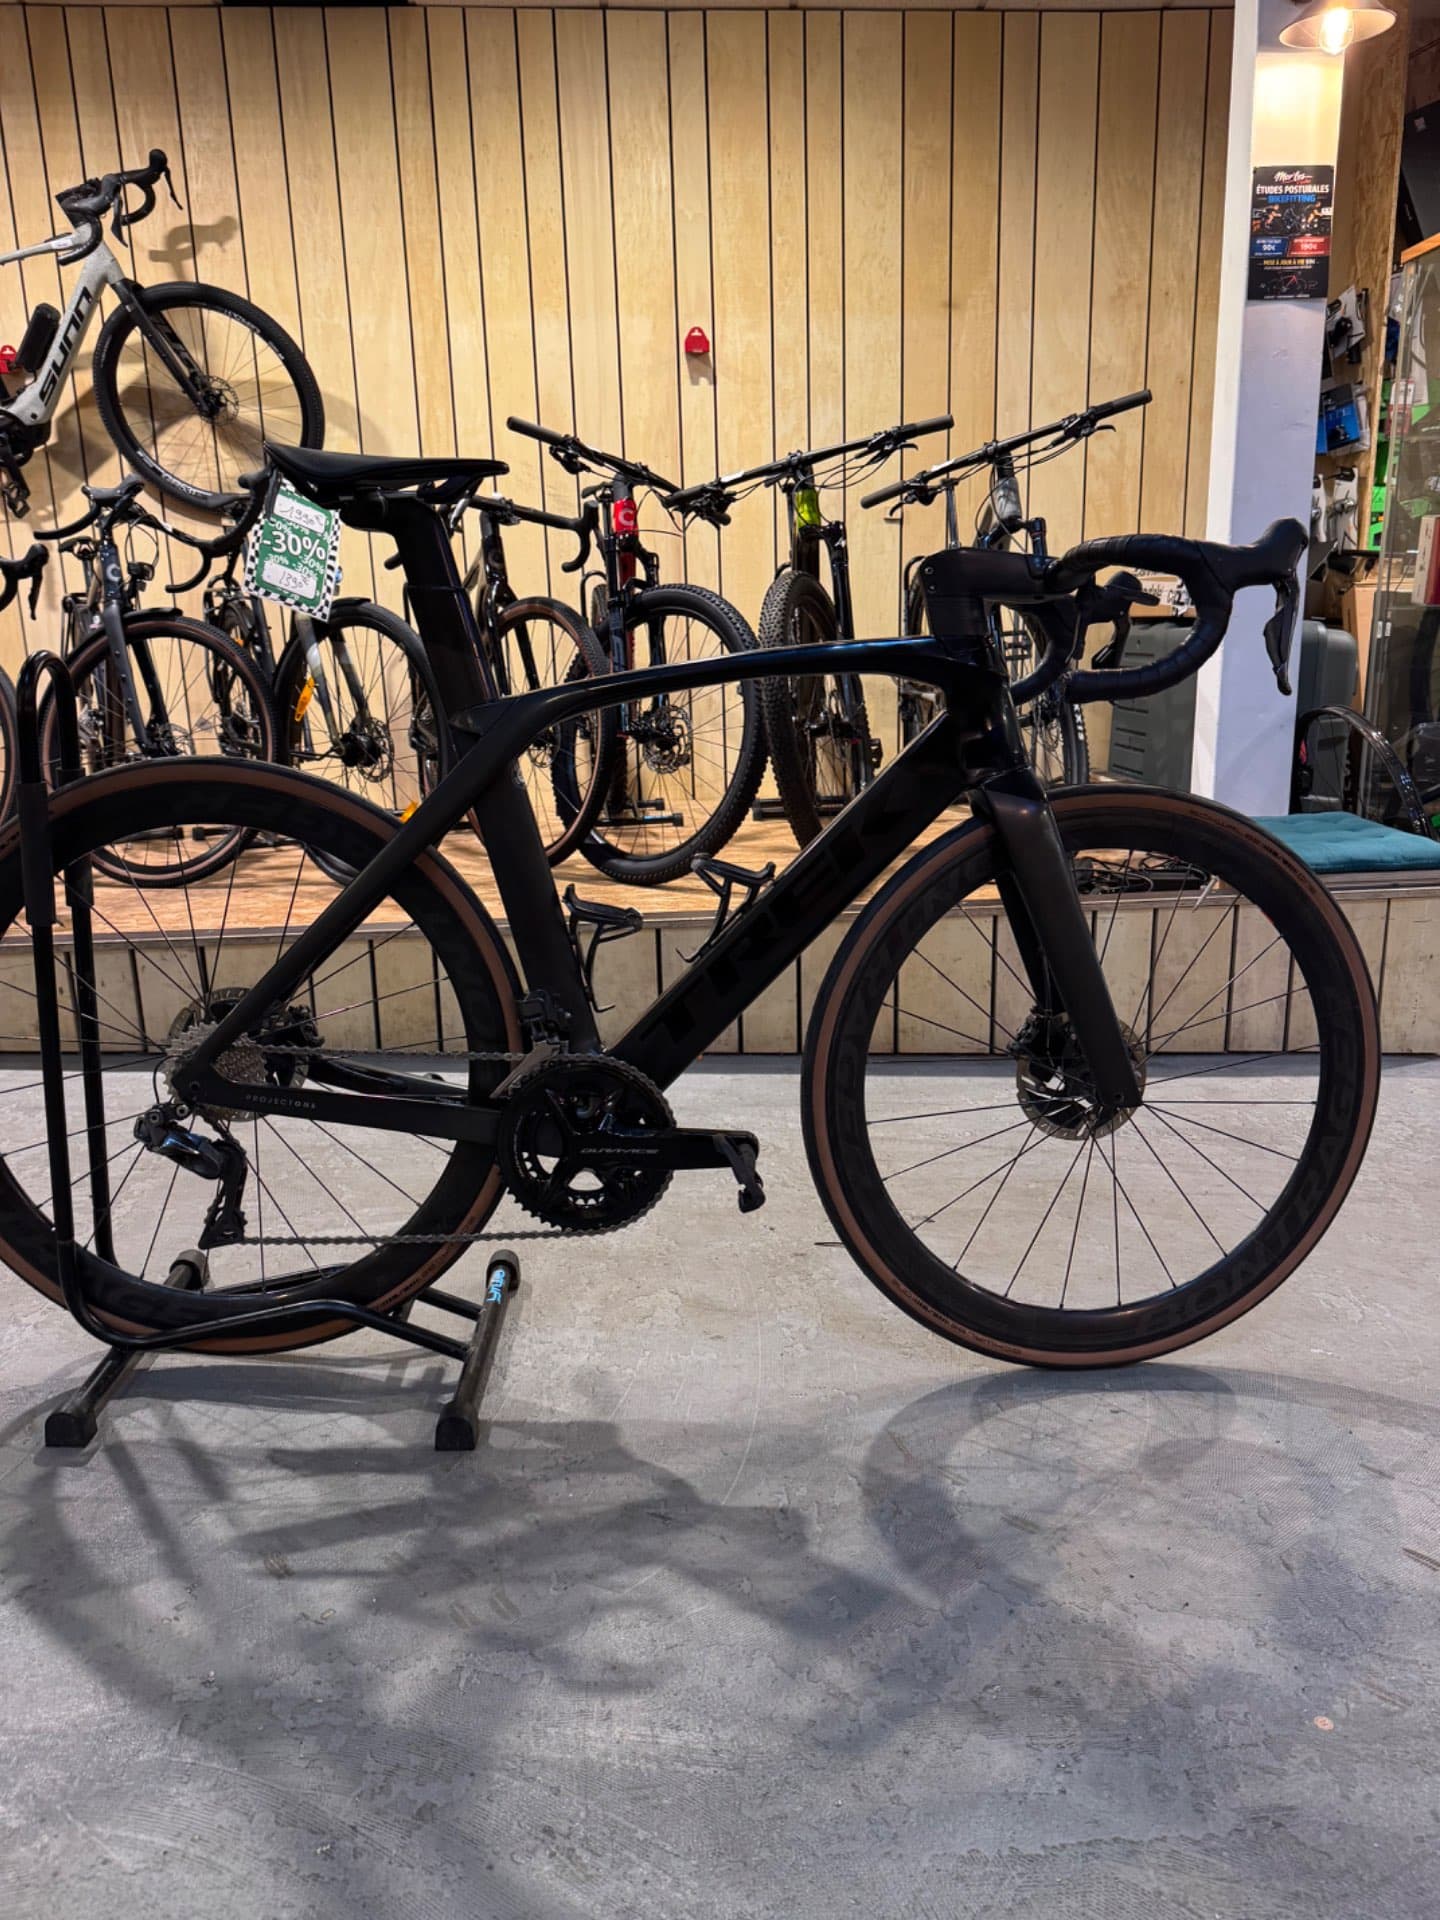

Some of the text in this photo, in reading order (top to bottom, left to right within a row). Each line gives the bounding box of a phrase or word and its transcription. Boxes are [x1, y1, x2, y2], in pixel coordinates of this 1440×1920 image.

[1256, 184, 1330, 194] ÉTUDES POSTURALES
[262, 531, 326, 560] -30%
[640, 788, 912, 1044] TREK
